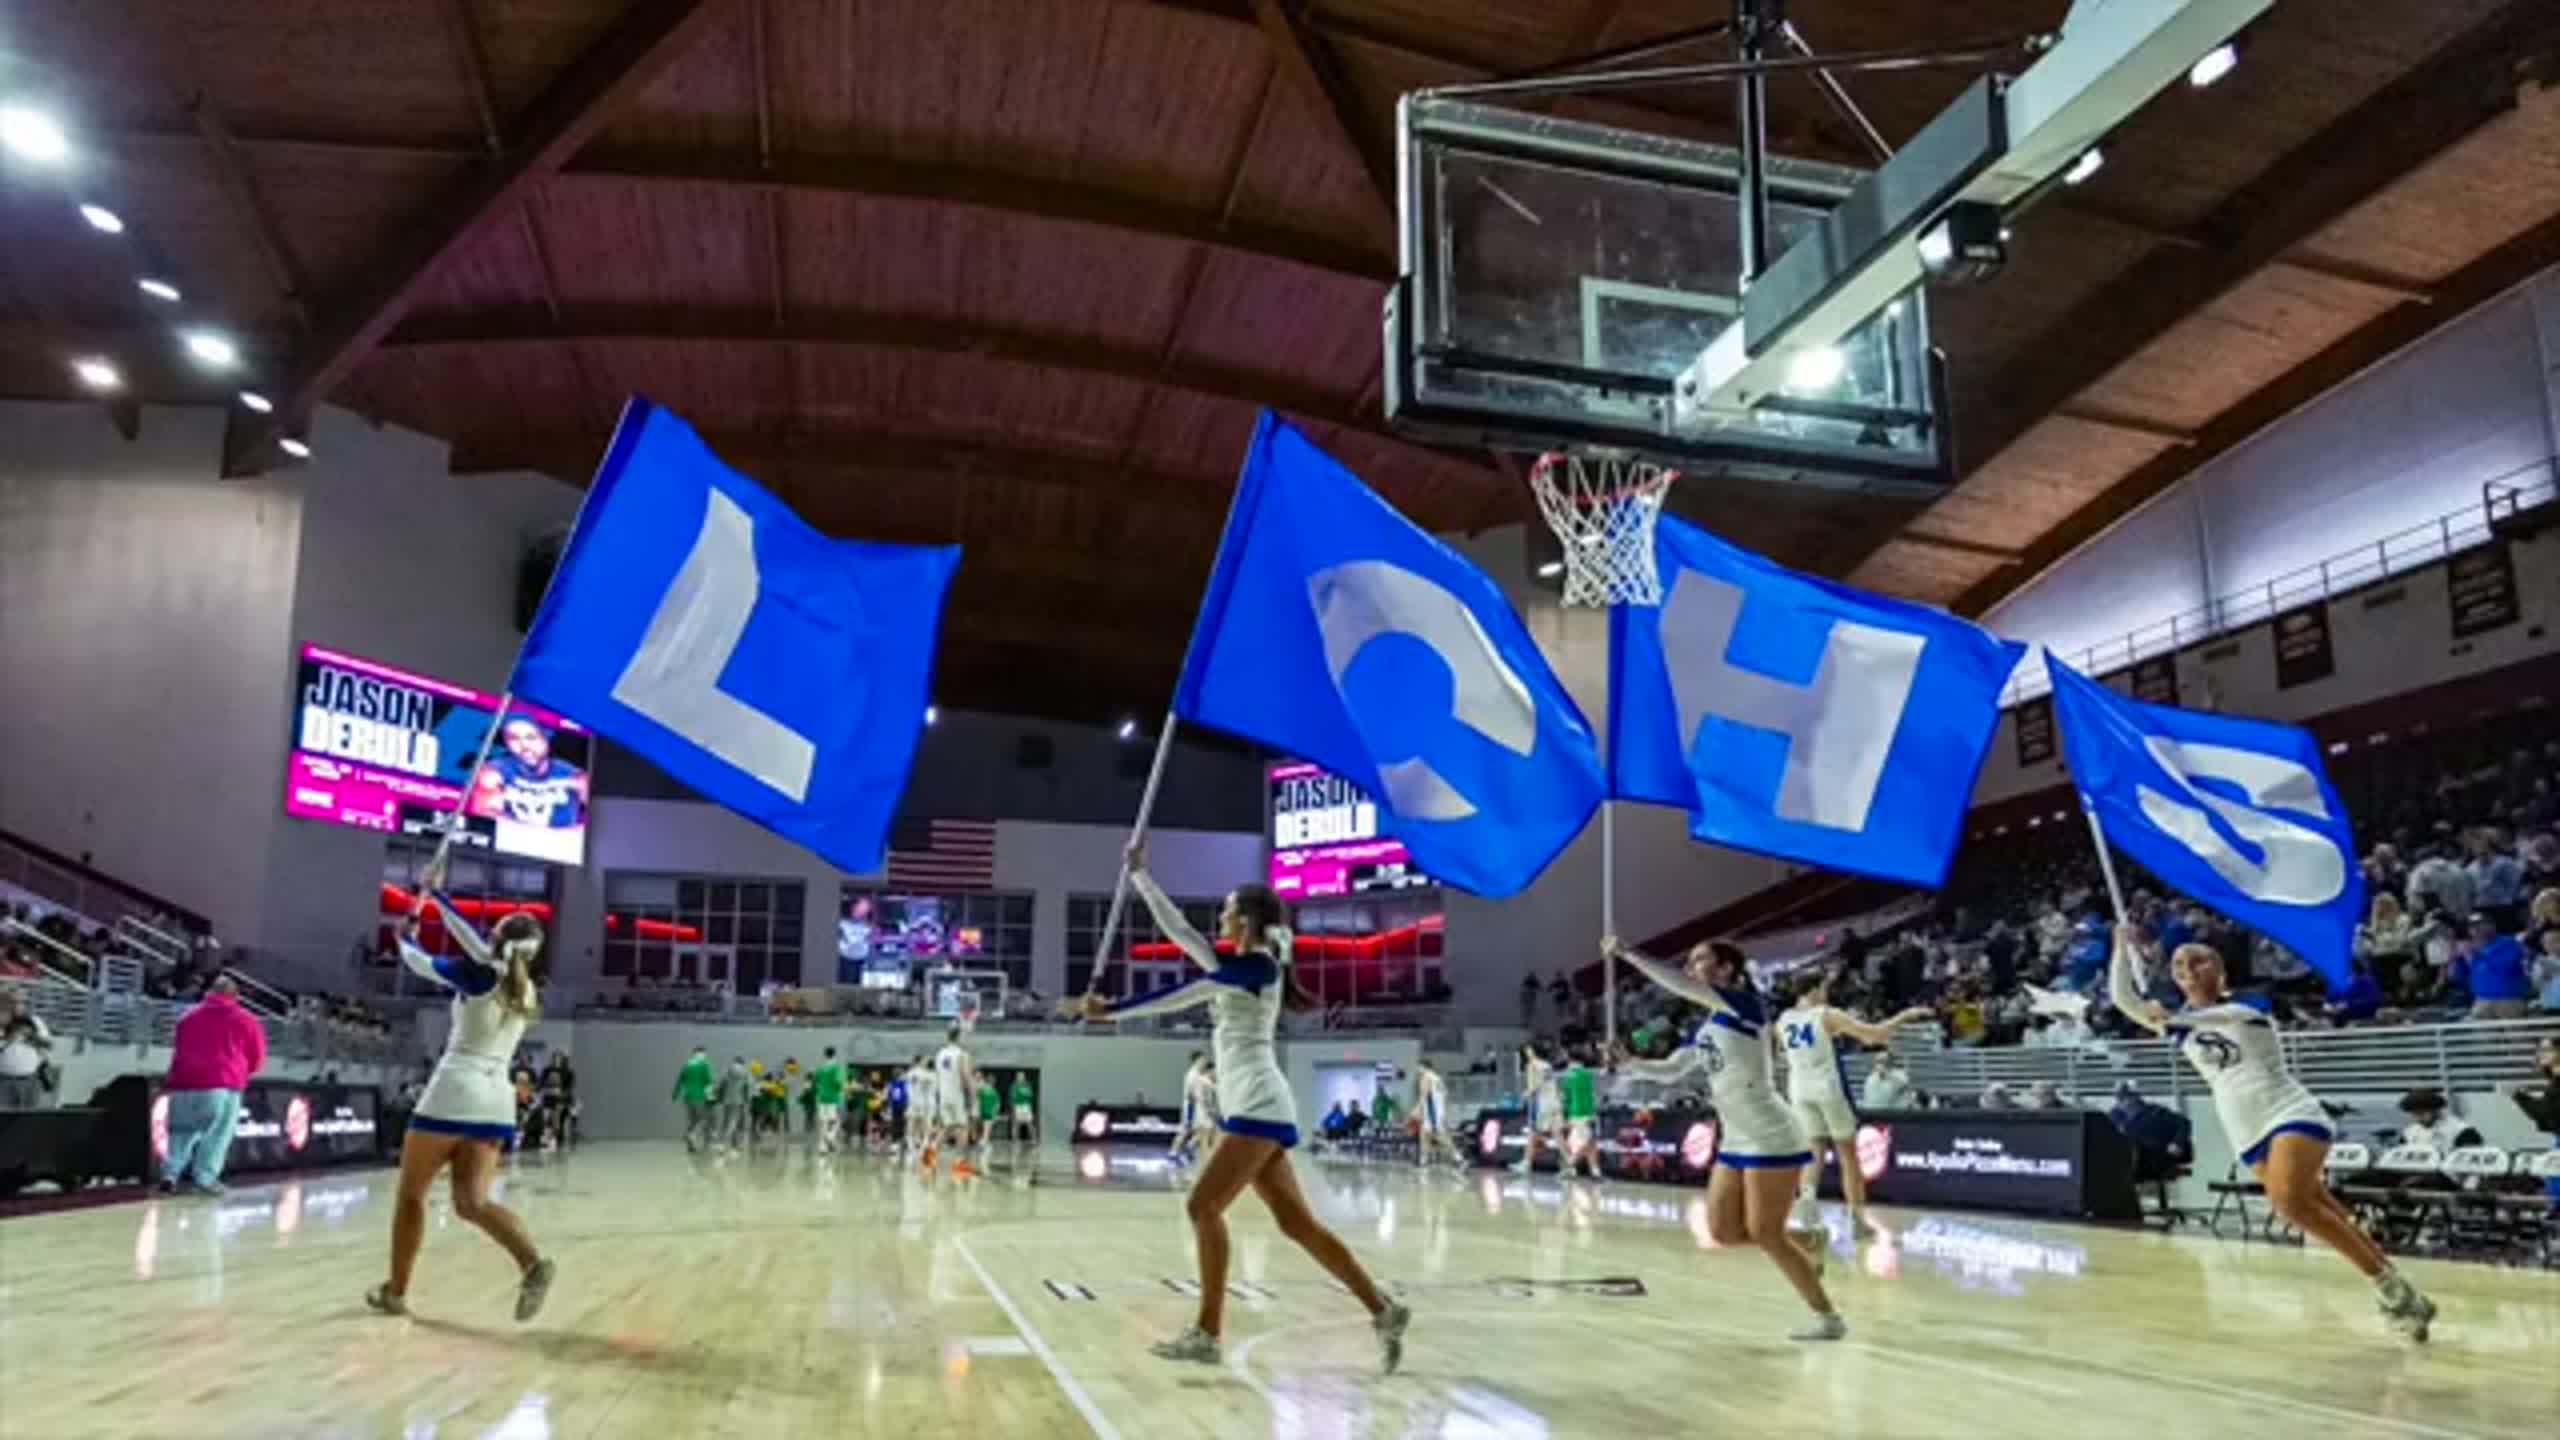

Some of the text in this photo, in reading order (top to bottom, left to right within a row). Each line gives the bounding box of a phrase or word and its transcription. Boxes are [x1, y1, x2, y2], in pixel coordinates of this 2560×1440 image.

[304, 665, 434, 732] JASON
[610, 484, 817, 805] L
[1306, 559, 1538, 821] C
[1658, 567, 1929, 833] H
[2135, 734, 2347, 907] S
[1784, 1022, 1815, 1049] 24
